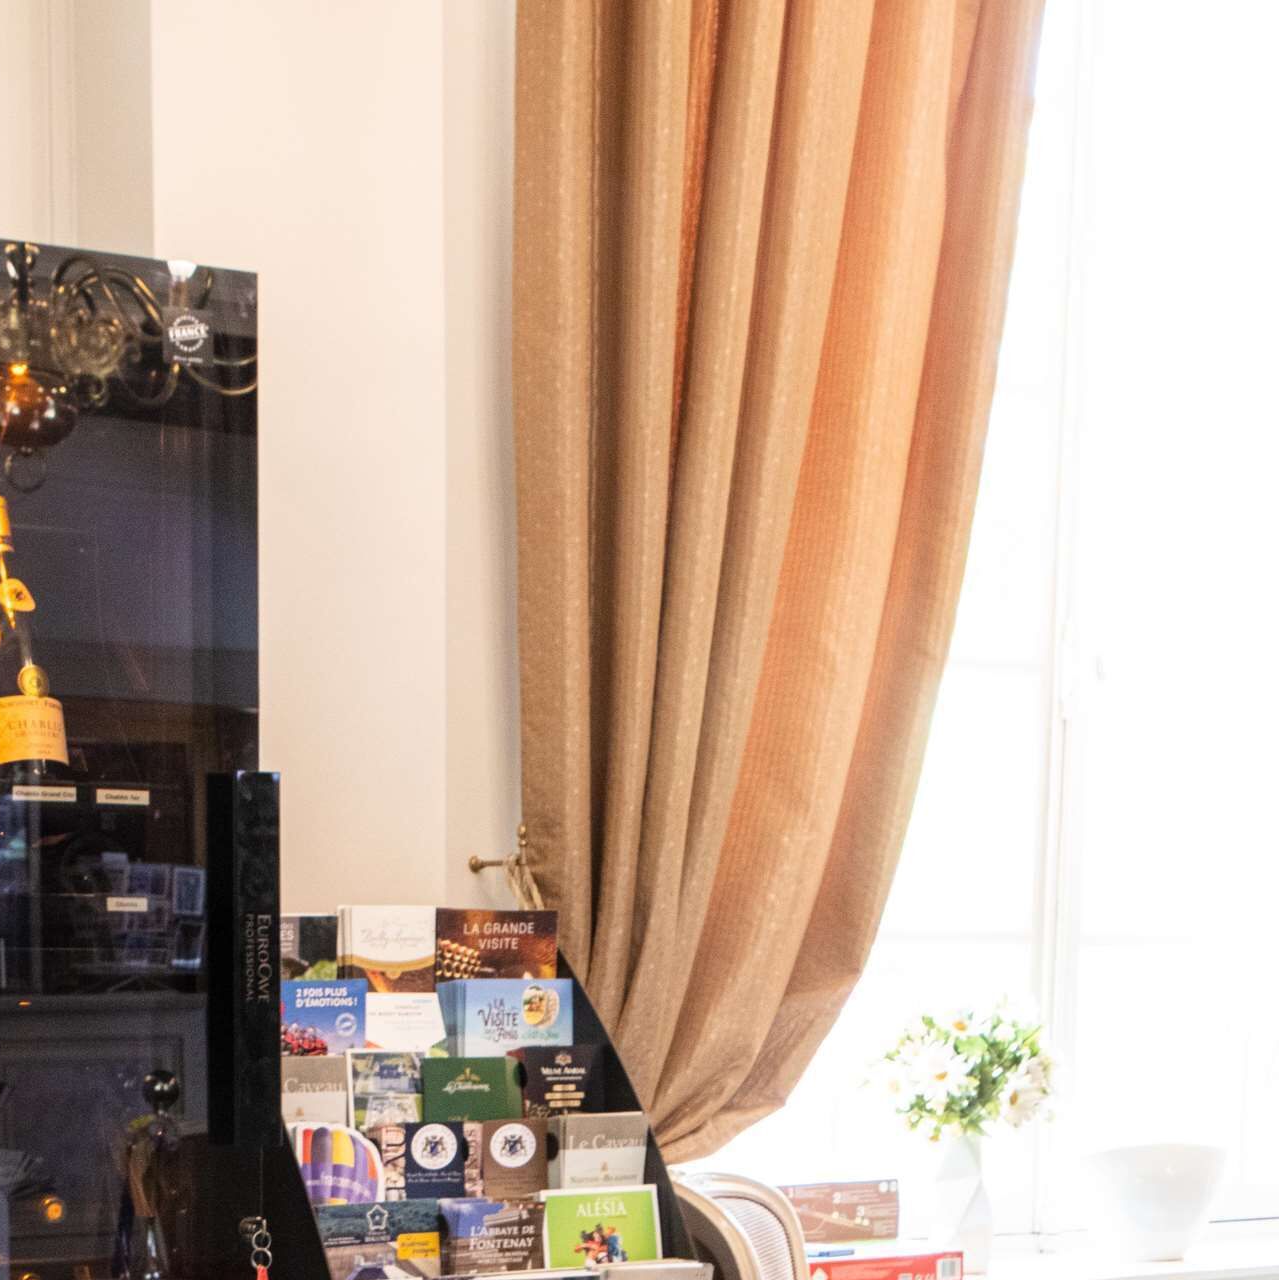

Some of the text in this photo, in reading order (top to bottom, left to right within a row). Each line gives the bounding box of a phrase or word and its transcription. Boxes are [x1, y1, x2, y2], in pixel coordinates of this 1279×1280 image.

[463, 922, 535, 936] LA GRANDE
[478, 937, 520, 950] VISITE
[303, 987, 323, 998] FOIS
[324, 986, 348, 997] PLUS
[569, 1134, 644, 1150] Le Caveau
[576, 1197, 628, 1217] ALÉSIA
[521, 1225, 536, 1234] DE
[469, 1236, 535, 1251] FONTENAY
